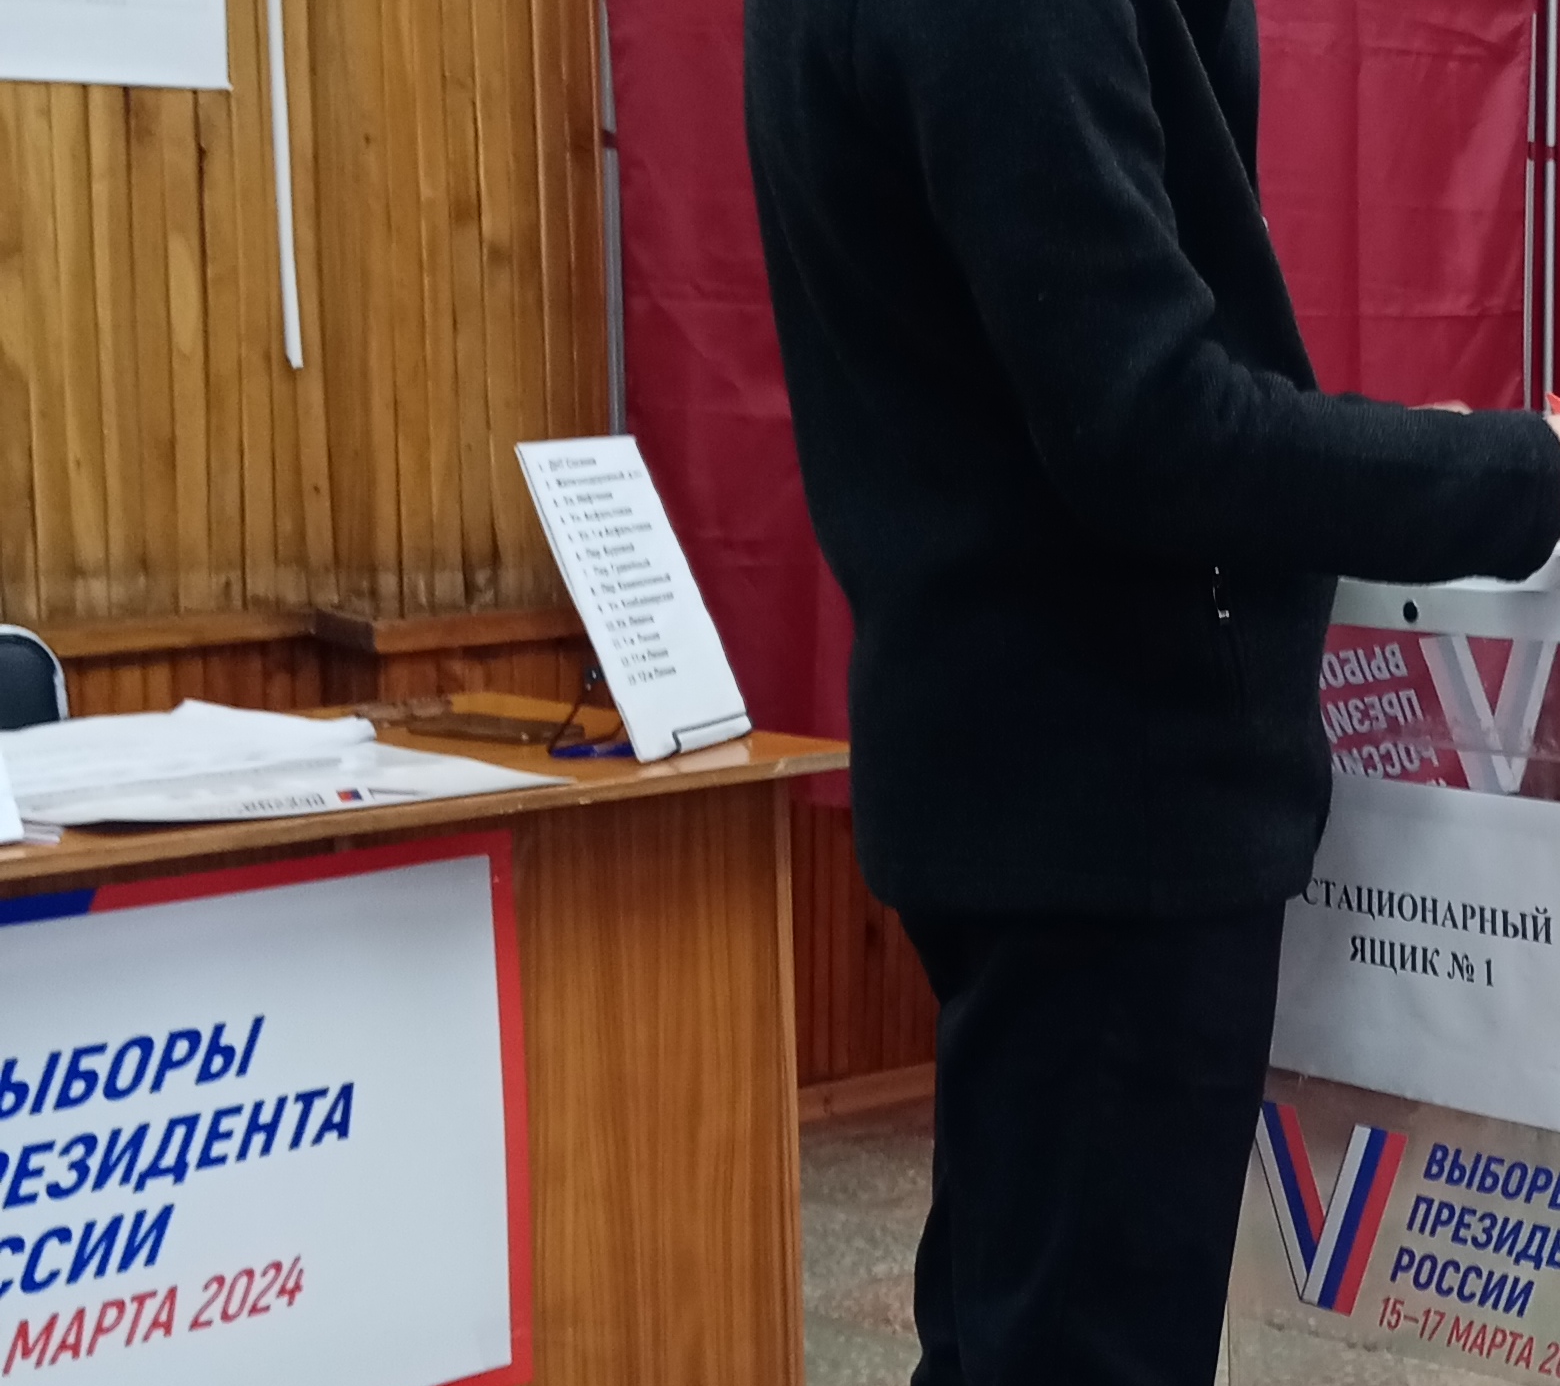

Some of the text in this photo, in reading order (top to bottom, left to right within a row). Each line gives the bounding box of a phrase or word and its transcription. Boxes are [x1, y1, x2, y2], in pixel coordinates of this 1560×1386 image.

[1302, 877, 1553, 945] СТАЦИОНАРНЫЙ
[1350, 934, 1495, 988] ЯЩИК № 1
[0, 1082, 355, 1210] ЕЗИДЕНТА
[2, 1255, 305, 1377] МАРТА 2024
[1389, 1245, 1536, 1319] РОССИИ
[1446, 1314, 1536, 1370] МАРТА
